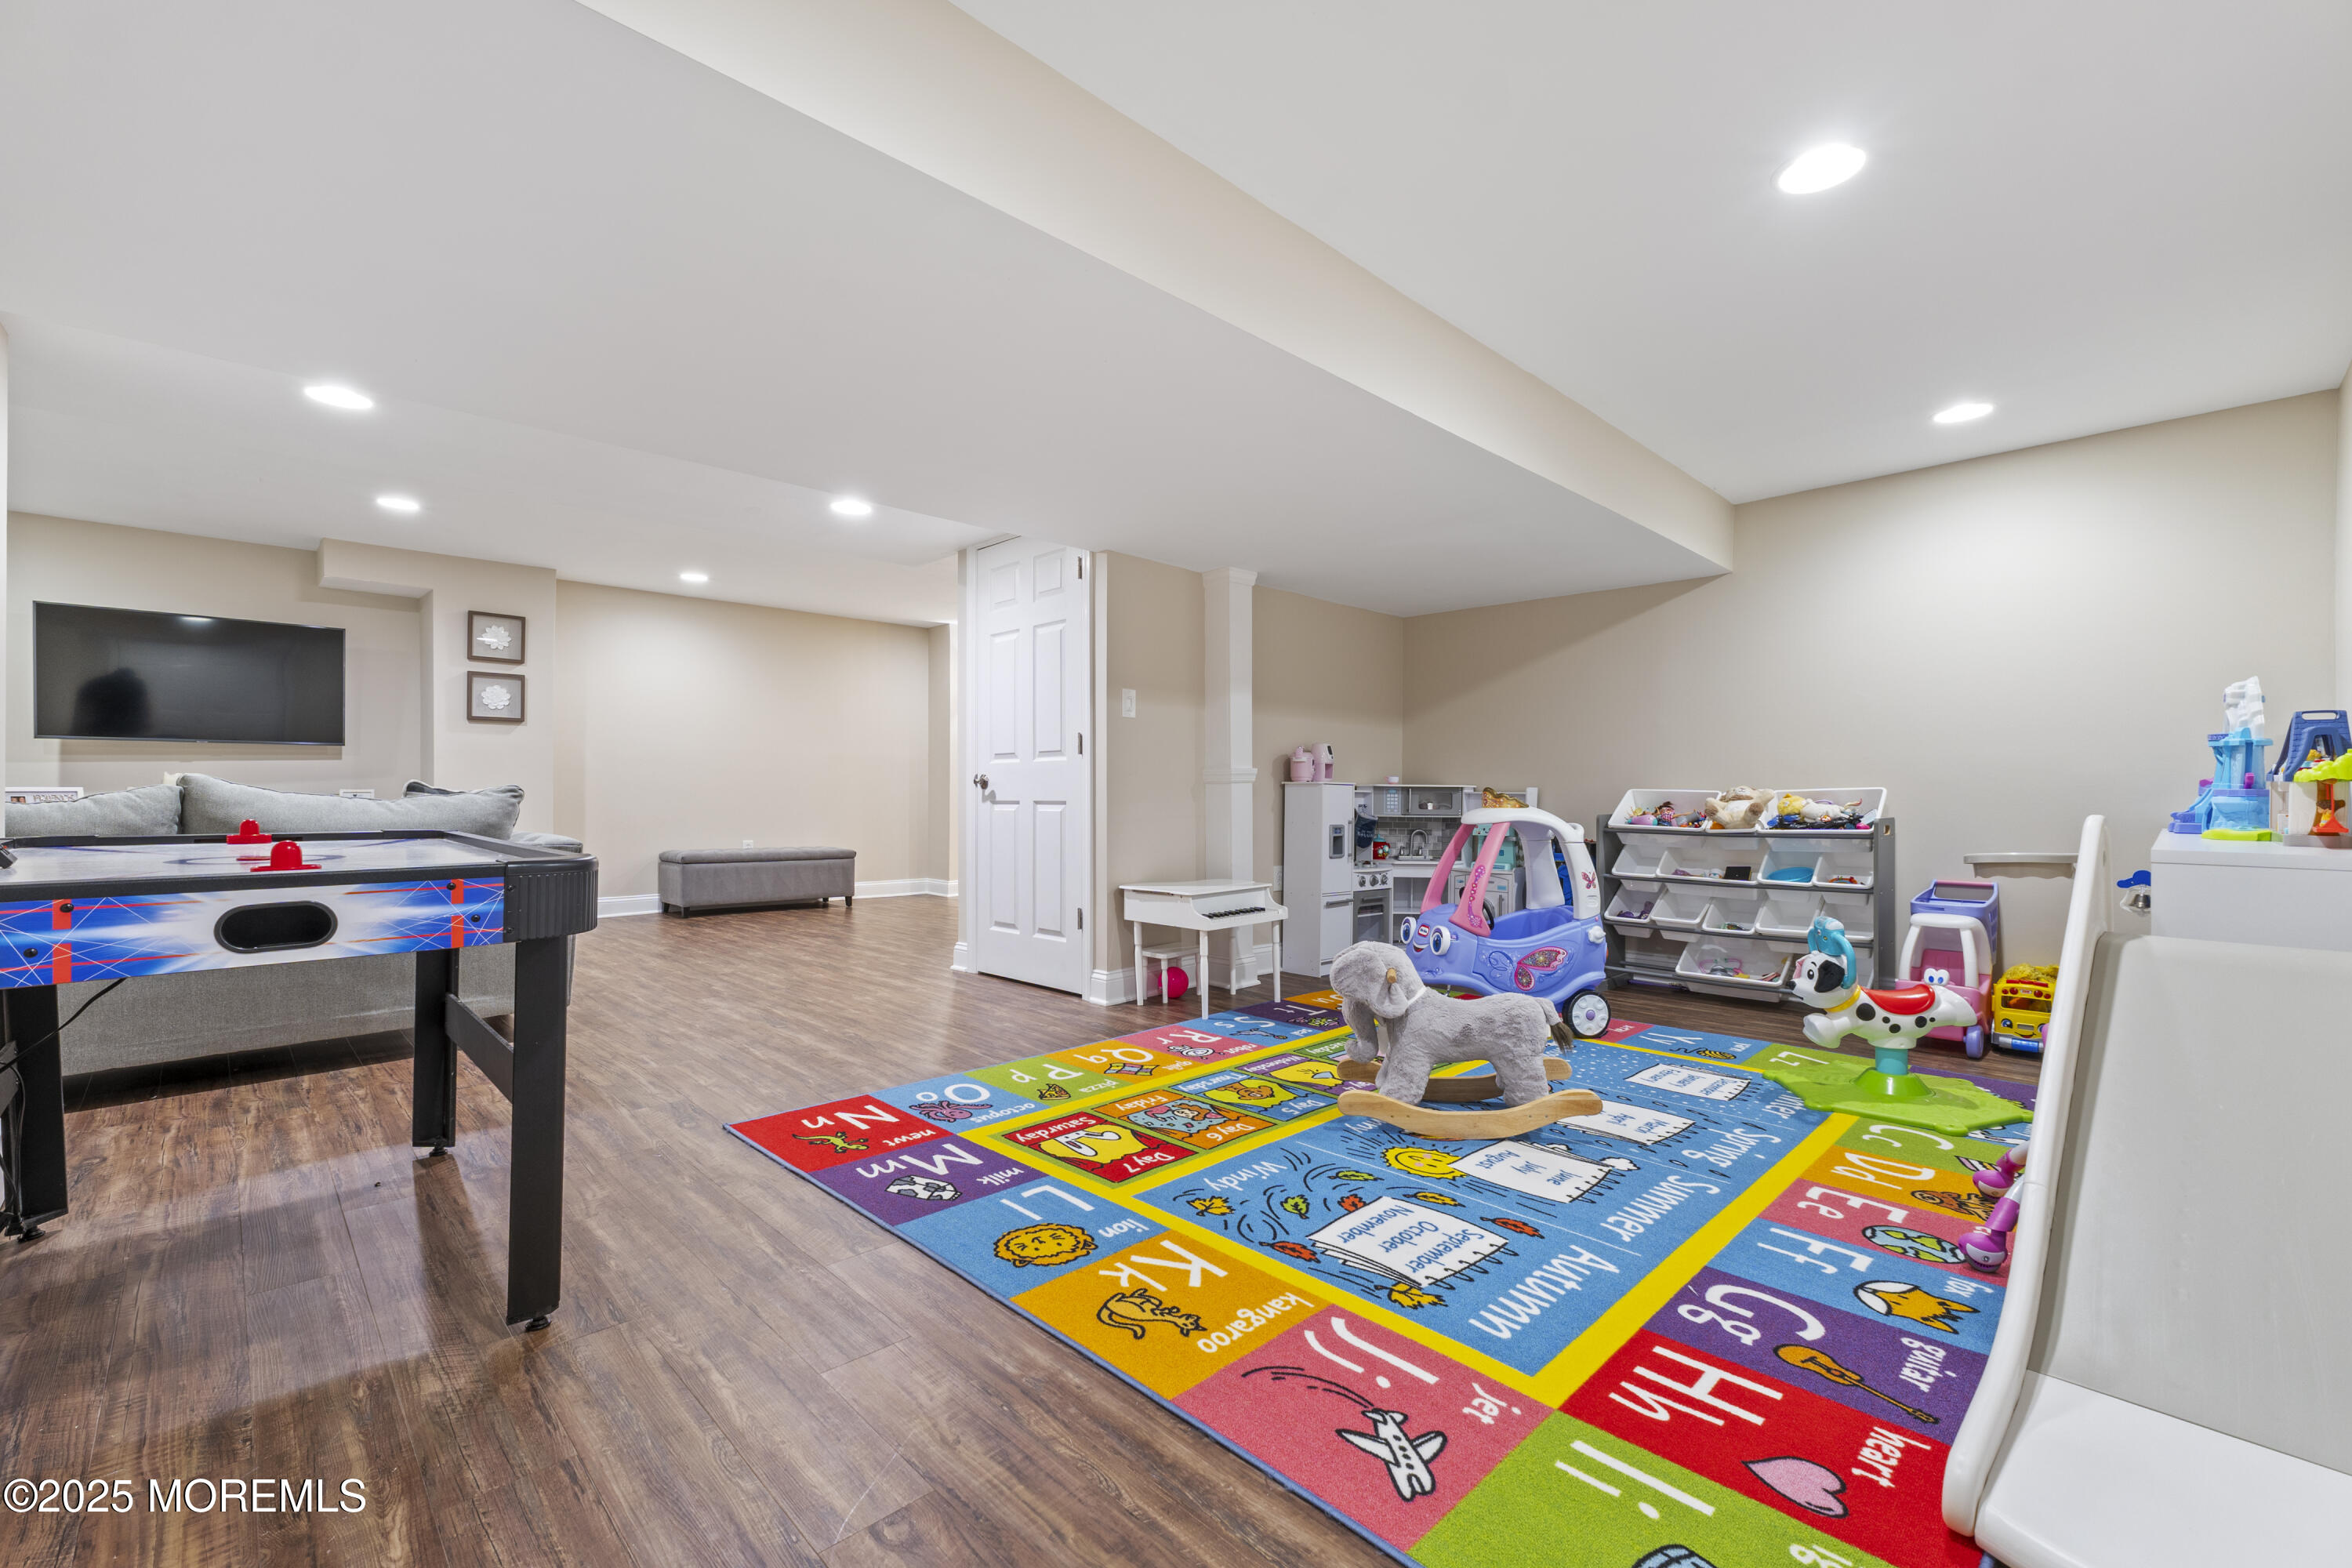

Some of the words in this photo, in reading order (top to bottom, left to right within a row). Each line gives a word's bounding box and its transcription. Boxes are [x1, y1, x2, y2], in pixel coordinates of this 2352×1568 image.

[1223, 1043, 1258, 1055] robot
[1305, 1040, 1347, 1054] uesday
[1161, 1059, 1192, 1072] quilt
[1243, 1054, 1307, 1073] Wednesday
[1079, 1079, 1116, 1094] pizza
[1178, 1071, 1251, 1094] Thursday
[970, 1103, 1036, 1124] octopus
[1116, 1094, 1168, 1112] Friday
[1281, 1106, 1301, 1116] 5
[1288, 1099, 1327, 1110] Day
[883, 1128, 936, 1148] newt
[1016, 1116, 1097, 1143] Saturday
[1206, 1132, 1224, 1142] 6
[1218, 1123, 1256, 1134] Day
[1137, 1152, 1175, 1164] Day
[1682, 1127, 1783, 1168] Spring
[1123, 1162, 1142, 1174] 7
[1475, 1149, 1520, 1170] August
[1510, 1160, 1548, 1175] July
[976, 1167, 1024, 1186] milk
[1207, 1160, 1290, 1192] Windy
[1546, 1169, 1584, 1186] June
[1600, 1174, 1721, 1243] Summer
[1098, 1218, 1147, 1240] lion
[1338, 1204, 1415, 1244] November
[1377, 1221, 1439, 1253] October
[1405, 1229, 1486, 1273] September
[1468, 1245, 1621, 1339] Autumn
[1944, 1276, 1994, 1298] fox
[1196, 1292, 1315, 1353] kangaroo
[1899, 1337, 1957, 1392] guitar
[1462, 1382, 1522, 1425] jet
[1852, 1426, 1931, 1488] heart
